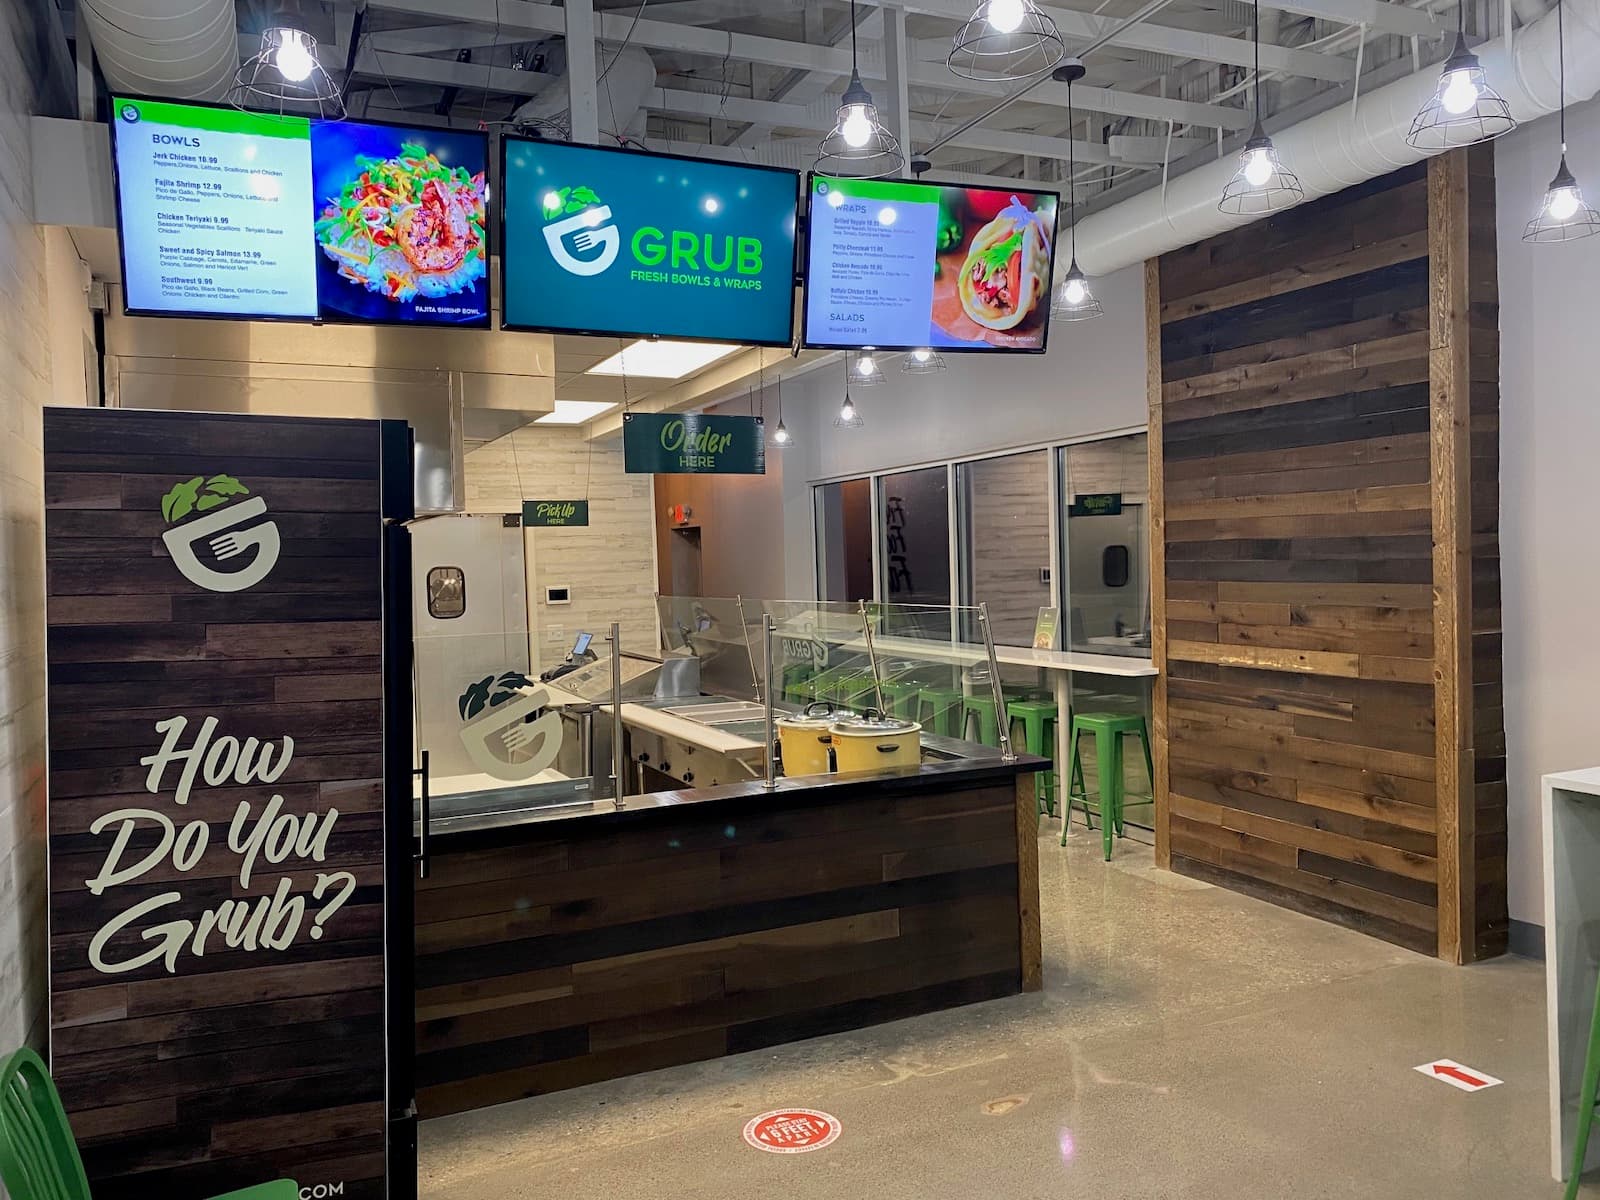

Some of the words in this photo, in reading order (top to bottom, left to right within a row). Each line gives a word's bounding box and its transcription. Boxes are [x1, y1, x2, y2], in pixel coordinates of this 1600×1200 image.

[152, 134, 200, 148] BOWLS
[153, 152, 168, 160] Jerk
[169, 153, 196, 162] Chicken
[154, 178, 174, 188] Fajita
[176, 180, 200, 190] Shrimp
[203, 182, 222, 190] 12.99
[156, 194, 176, 202] Shrimp
[835, 204, 867, 214] WRAPS
[157, 212, 184, 221] Chicken
[186, 214, 212, 224] Teriyaki
[214, 216, 229, 224] 9.99
[158, 220, 184, 228] Seasonal
[184, 222, 215, 231] Vegetables
[160, 246, 180, 254] Sweet
[196, 248, 214, 258] Spicy
[216, 250, 242, 258] Salmon
[631, 226, 763, 275] GRUB
[160, 254, 178, 262] Purple
[161, 276, 196, 284] Southwest
[197, 278, 213, 286] 9.99
[630, 270, 668, 284] FRESH
[672, 273, 710, 287] BOWLS
[714, 278, 720, 288] &
[724, 279, 762, 291] WRAPS
[830, 313, 865, 322] SALADS
[660, 420, 732, 454] Order
[679, 455, 716, 468] HERE
[536, 503, 561, 518] Pick
[140, 716, 294, 804] How
[85, 808, 210, 896] Do
[228, 794, 338, 889] You
[88, 871, 356, 974] Grub?
[769, 1129, 782, 1138] 6
[782, 1122, 814, 1136] FEET
[777, 1128, 820, 1144] APART
